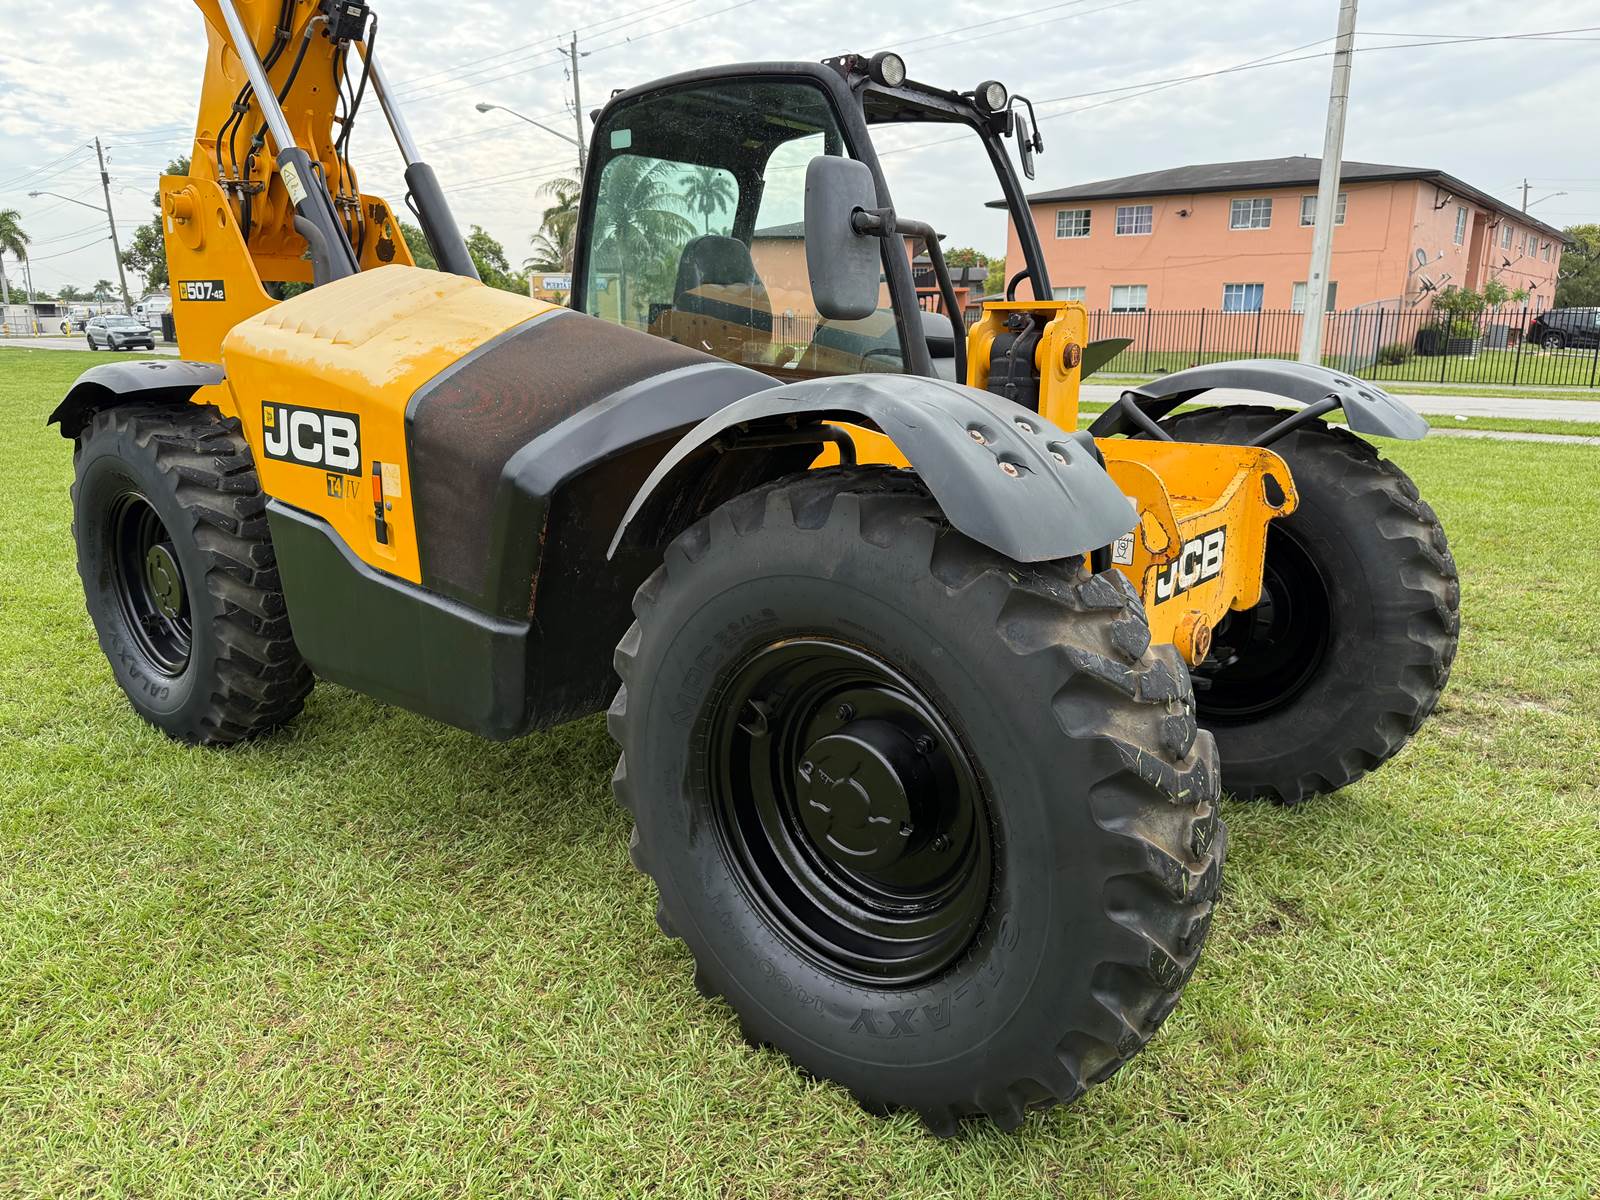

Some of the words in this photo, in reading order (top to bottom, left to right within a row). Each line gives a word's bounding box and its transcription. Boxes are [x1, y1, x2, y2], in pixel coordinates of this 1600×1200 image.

[264, 408, 359, 470] JCB
[328, 476, 343, 497] T4
[1157, 531, 1225, 598] JCB
